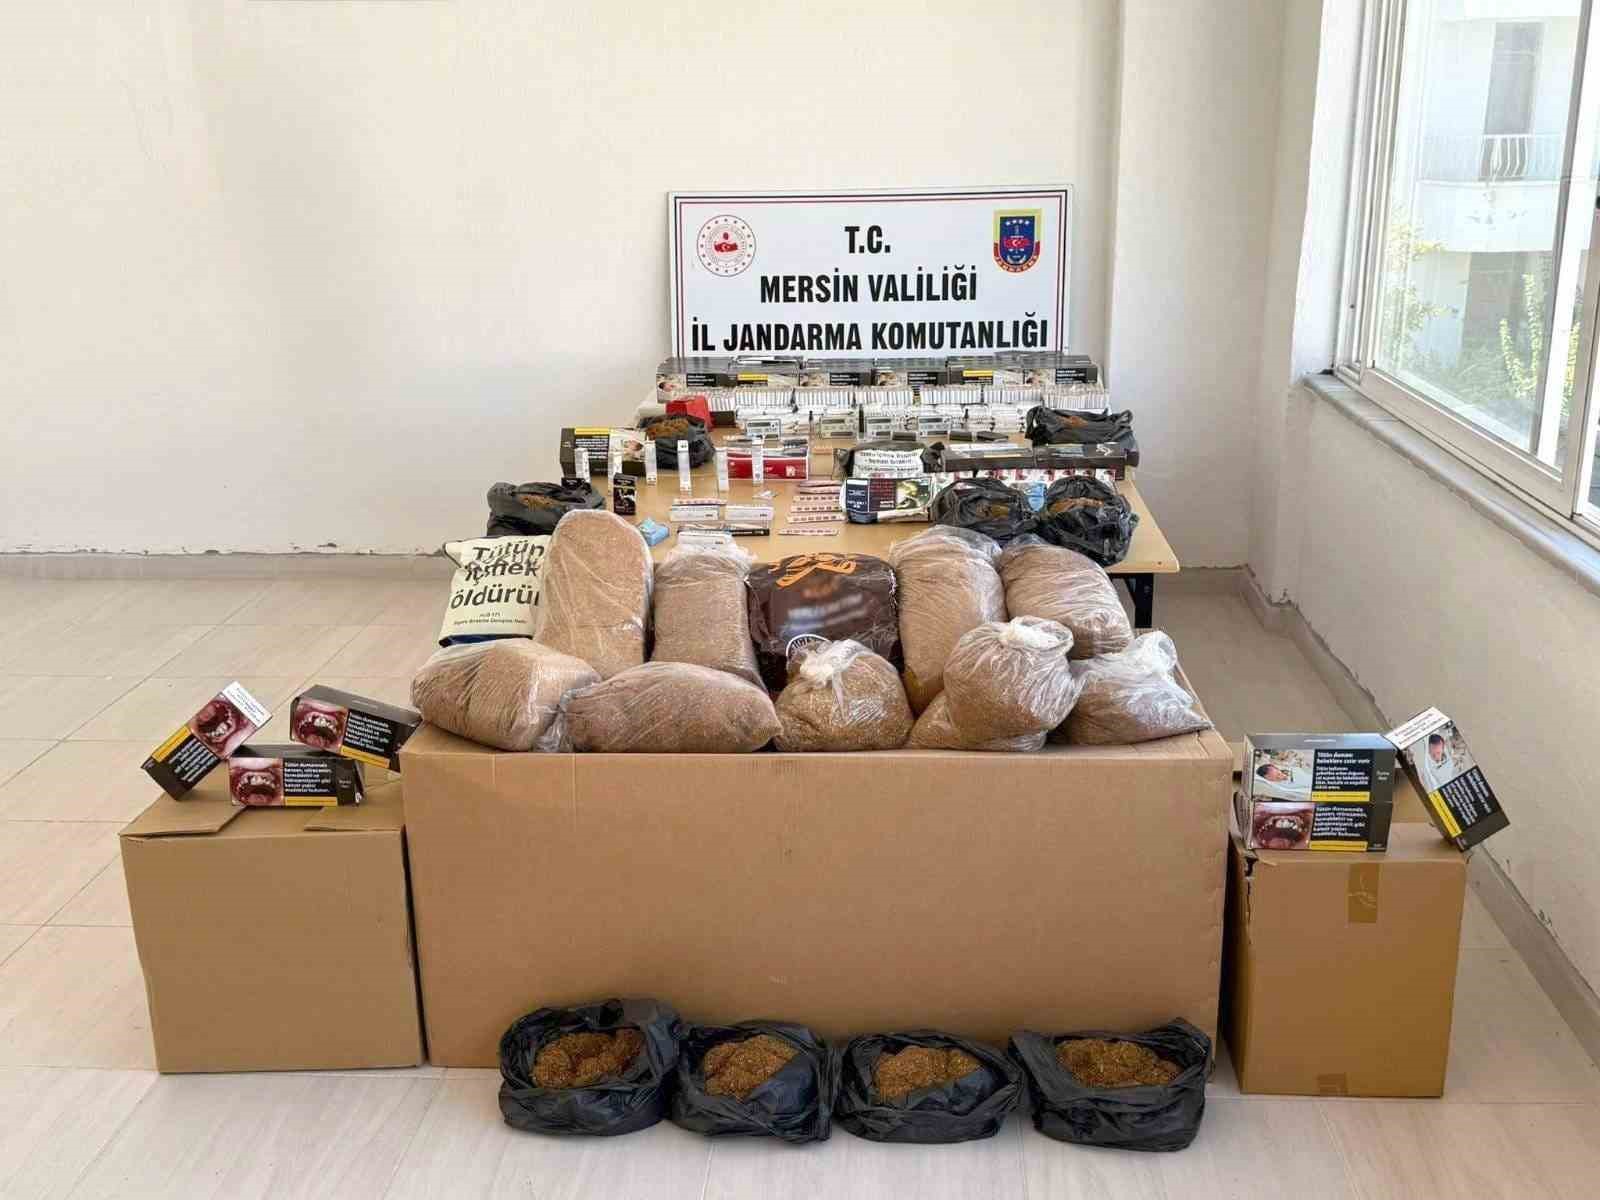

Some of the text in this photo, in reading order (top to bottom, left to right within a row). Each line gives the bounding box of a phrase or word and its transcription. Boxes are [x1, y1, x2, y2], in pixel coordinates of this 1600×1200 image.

[845, 225, 892, 255] T.C.
[760, 265, 977, 303] MERSİN VALİLİĞİ
[692, 311, 1048, 352] İL JANDARMA KOMUTANLIĞI
[472, 540, 545, 563] Tütün
